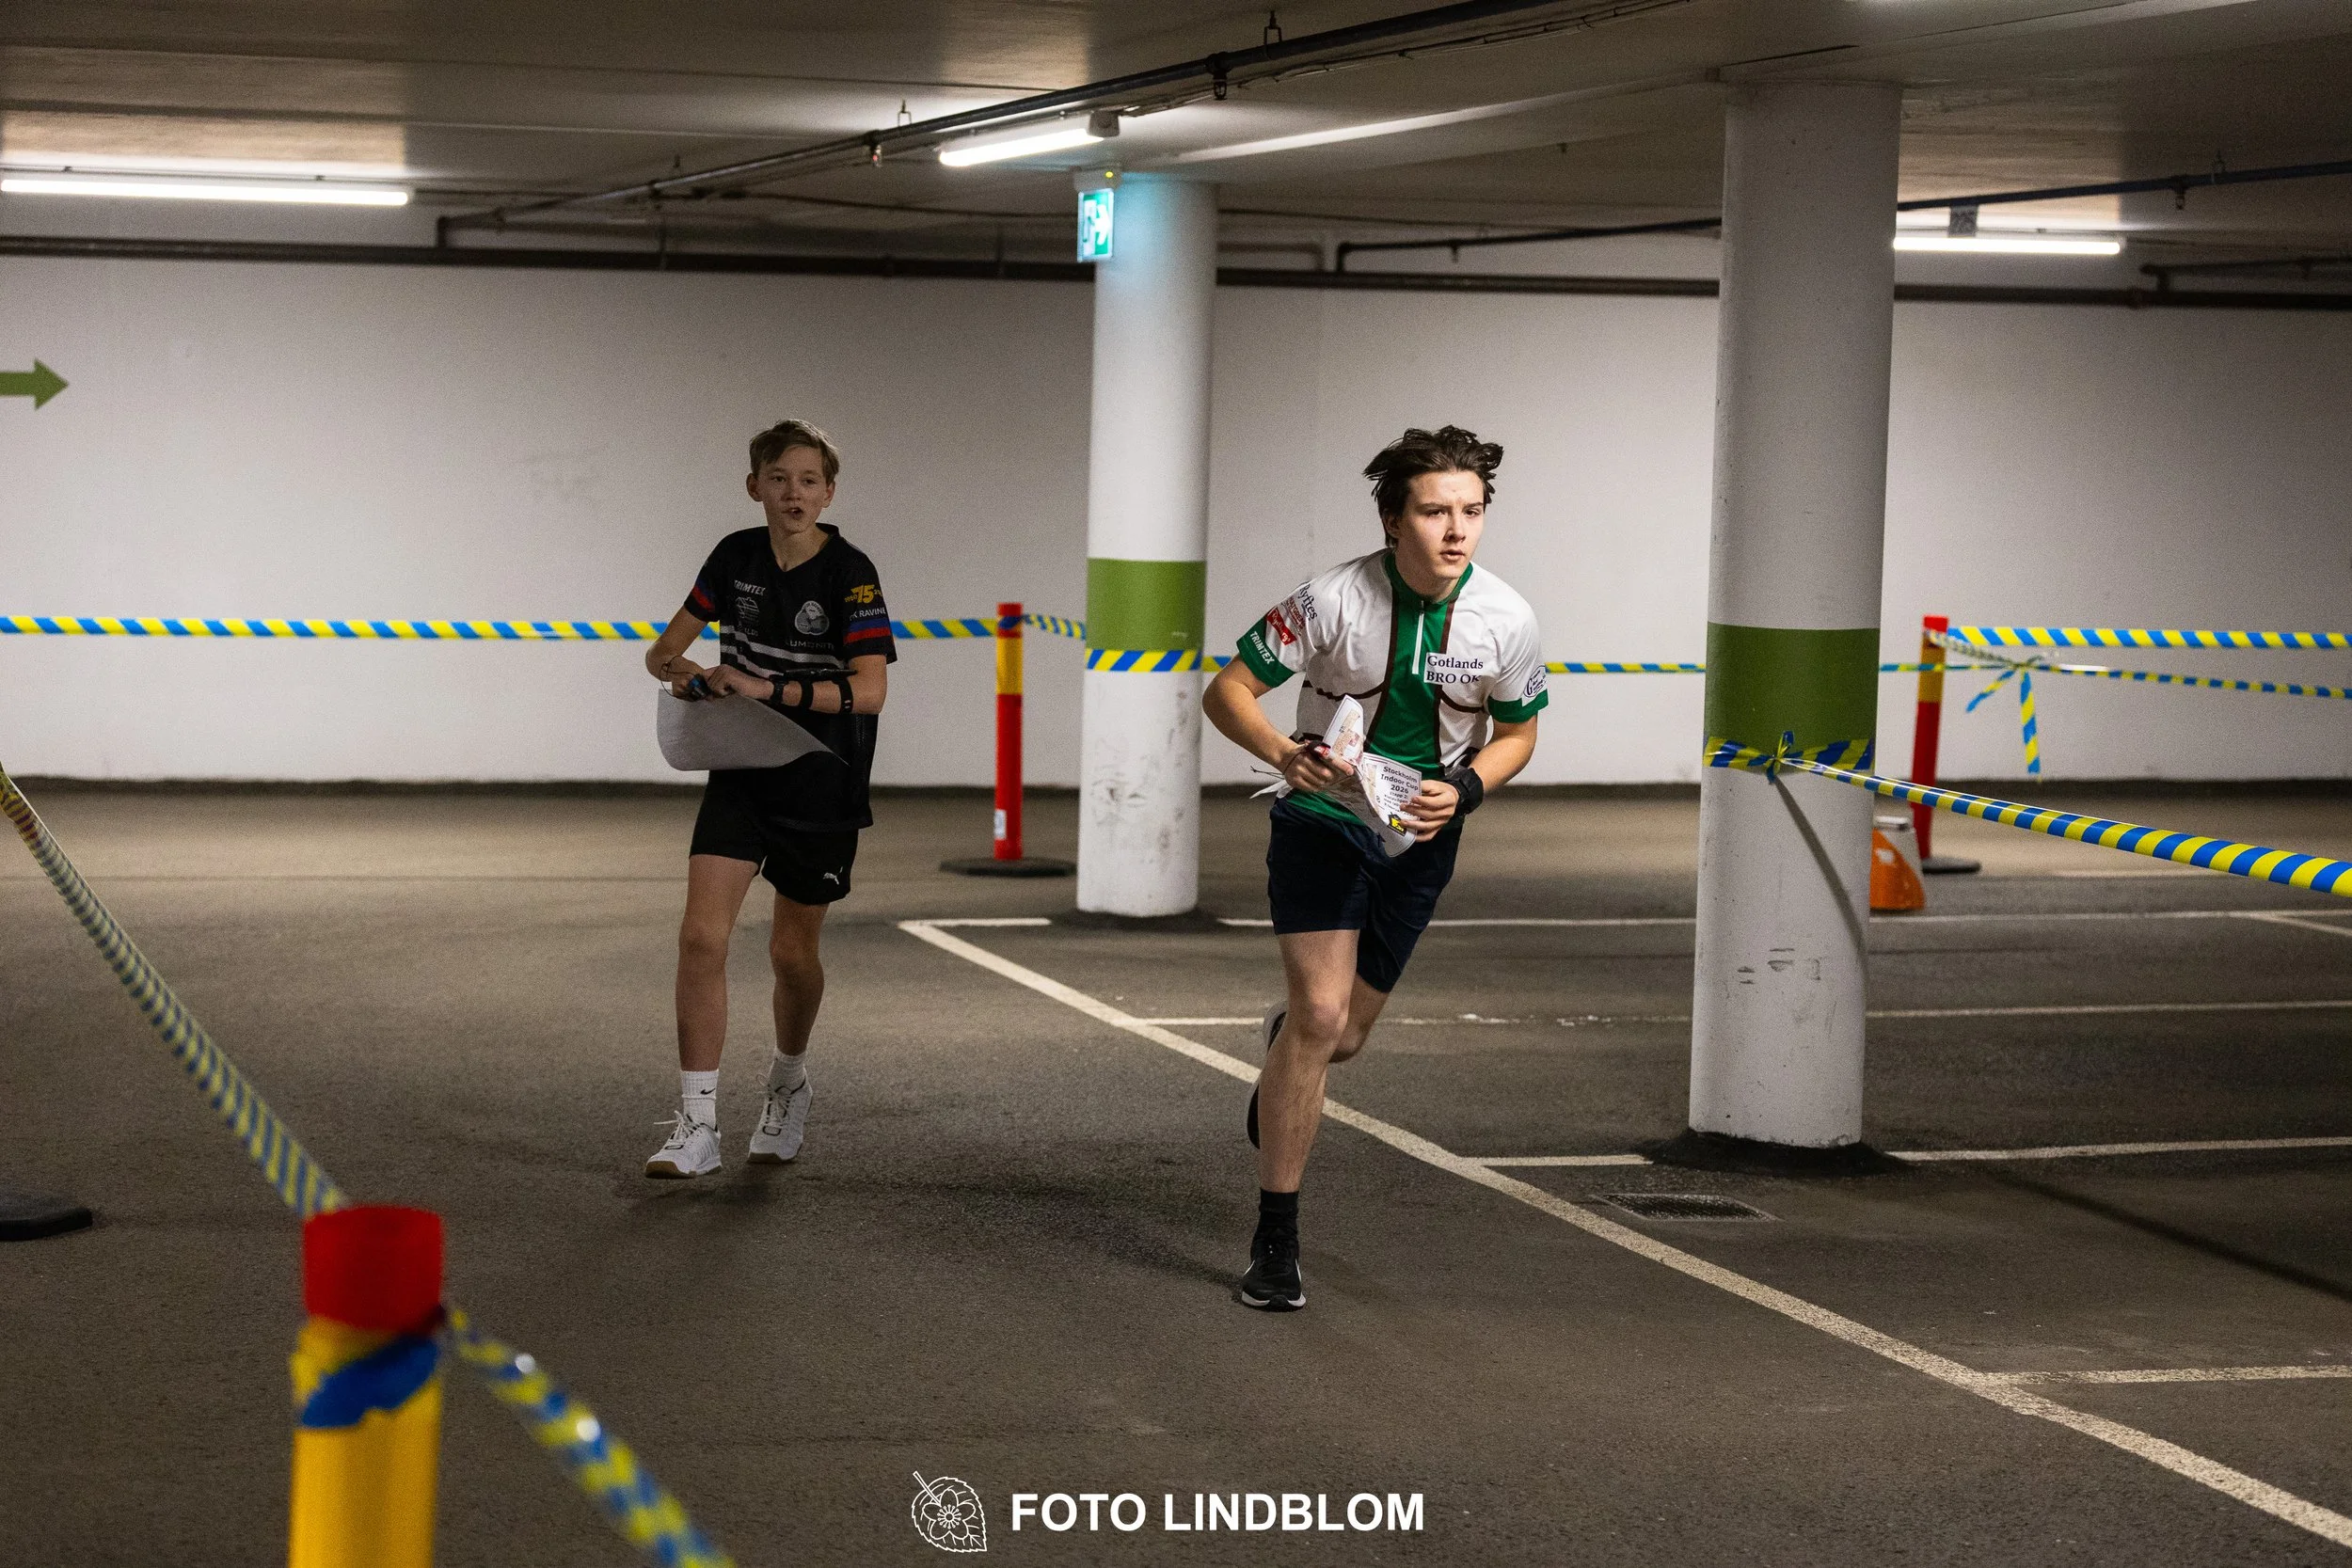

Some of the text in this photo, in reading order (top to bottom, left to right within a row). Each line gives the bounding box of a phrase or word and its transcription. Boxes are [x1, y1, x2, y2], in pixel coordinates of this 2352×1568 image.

[734, 579, 766, 596] TRIMTEX
[850, 584, 876, 604] 75
[1250, 630, 1275, 664] TRIMTEX
[1427, 656, 1484, 669] Gotlands
[1426, 671, 1456, 684] BRO
[1381, 774, 1419, 791] Indoor Cup
[1383, 766, 1418, 784] Stockholm
[1391, 784, 1409, 795] 2026
